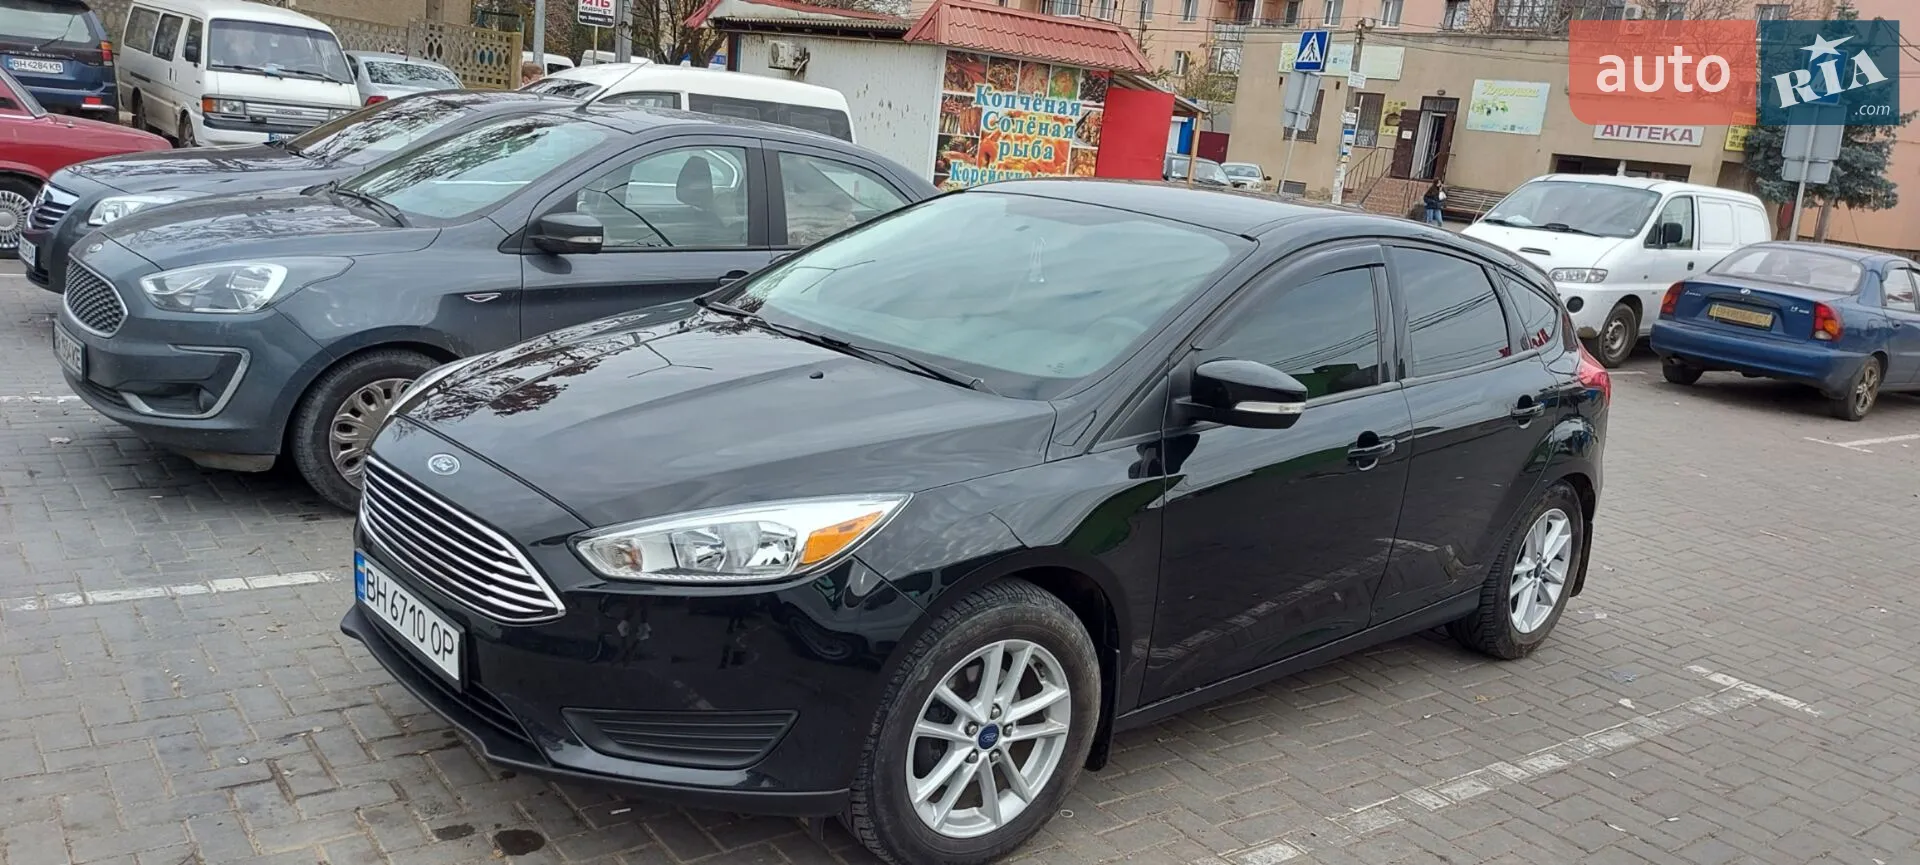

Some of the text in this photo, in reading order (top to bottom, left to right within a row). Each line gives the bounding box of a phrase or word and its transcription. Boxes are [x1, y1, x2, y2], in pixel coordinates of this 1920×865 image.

[974, 84, 1082, 117] Копчёная
[982, 110, 1076, 139] Солёная
[1601, 125, 1694, 143] АПТЕКА
[998, 139, 1054, 161] рыба
[366, 568, 454, 662] BH 6710 OP
